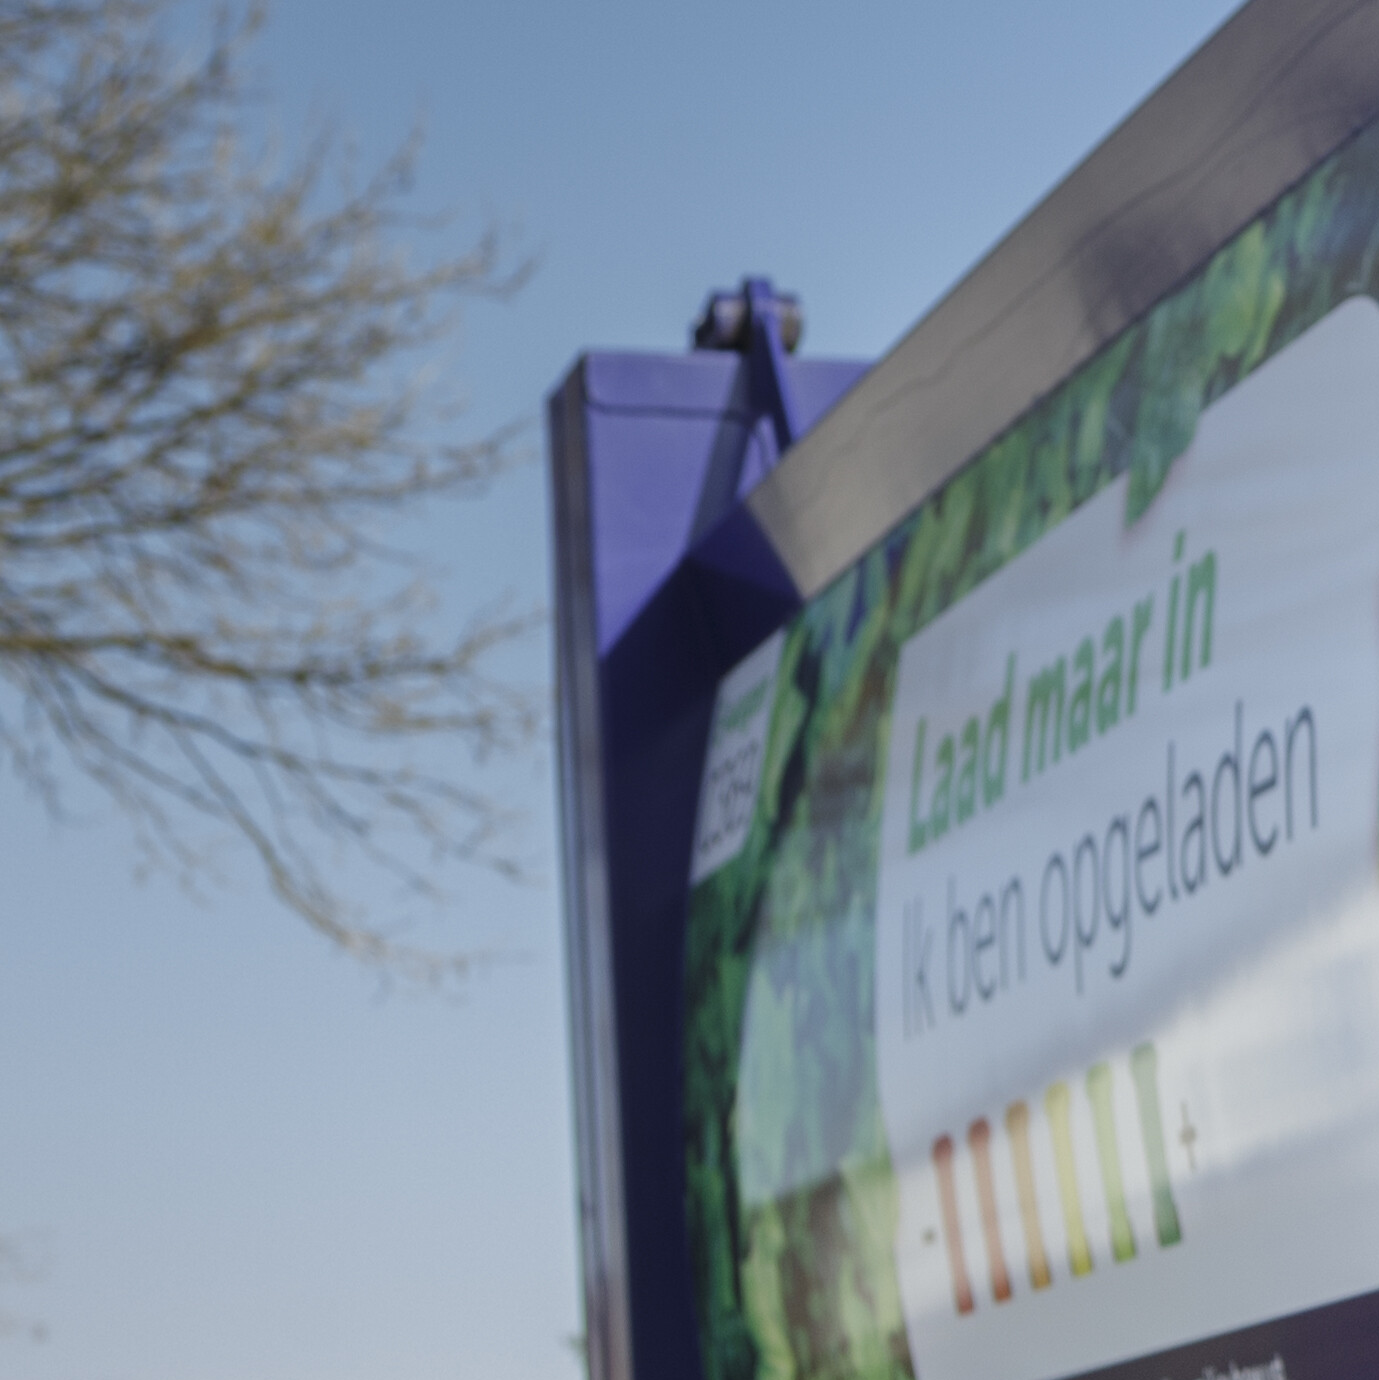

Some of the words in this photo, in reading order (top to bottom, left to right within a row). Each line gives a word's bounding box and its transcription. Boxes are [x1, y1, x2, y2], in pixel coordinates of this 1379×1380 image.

[907, 650, 1017, 858] Laad
[1020, 593, 1155, 785] maar
[1162, 528, 1218, 694] in
[900, 896, 938, 1043] Ik
[946, 874, 1028, 1018] ben
[1039, 699, 1320, 997] opgeladen
